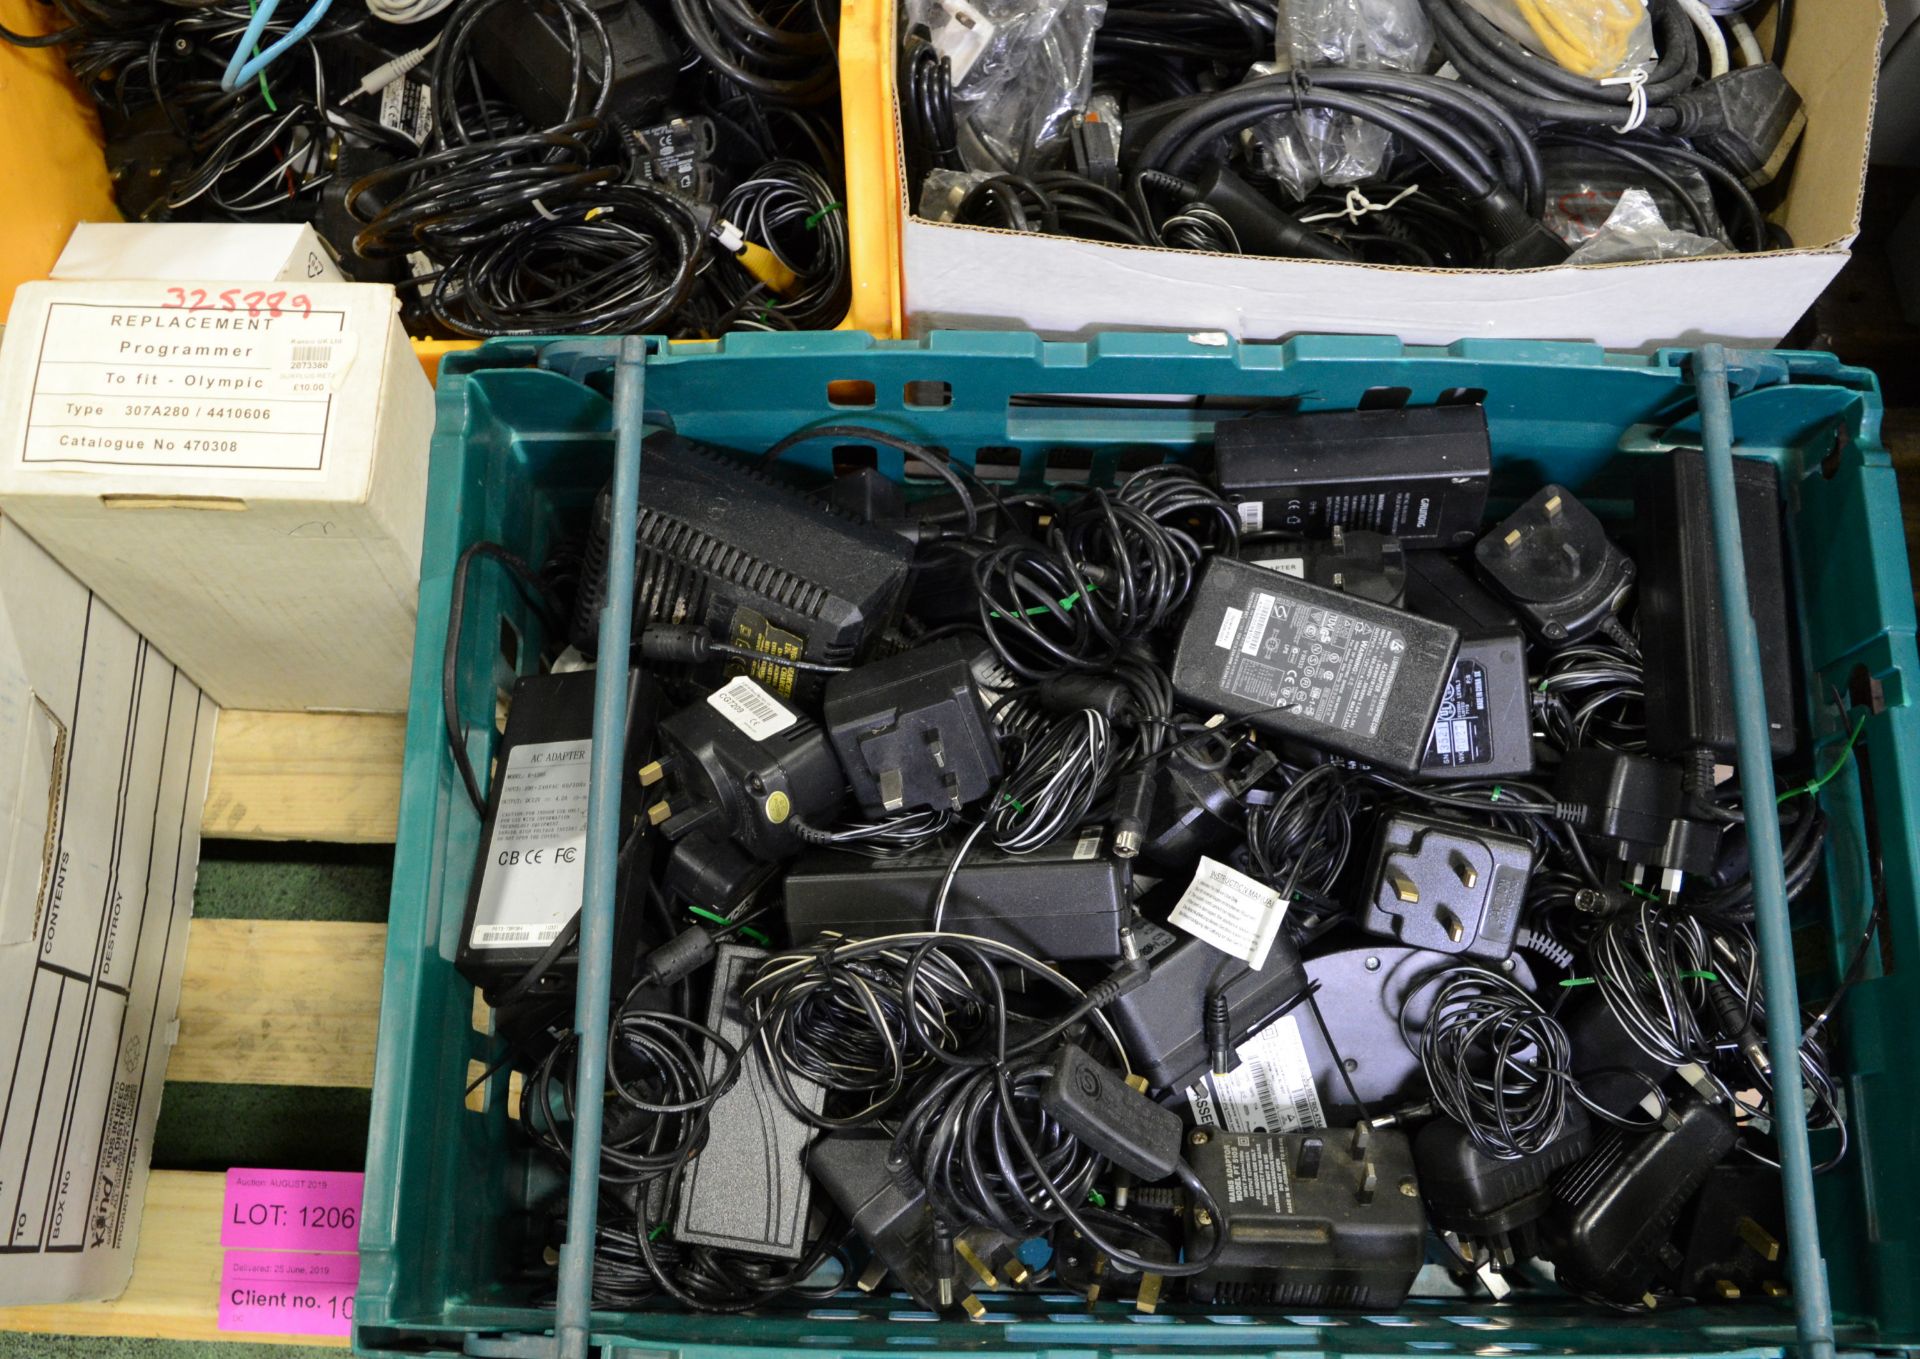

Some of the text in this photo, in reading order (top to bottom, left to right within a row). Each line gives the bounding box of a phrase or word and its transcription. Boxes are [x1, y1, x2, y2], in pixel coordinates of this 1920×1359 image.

[111, 315, 274, 330] REPLACEMENT
[120, 341, 253, 358] Programmer
[106, 372, 126, 384] To
[136, 374, 158, 385] fit
[184, 374, 264, 389] Olympic
[66, 403, 104, 416] Type
[125, 405, 190, 417] 307A280
[207, 407, 271, 420] 4410606
[59, 435, 238, 452] Catalogue No 470308
[1416, 497, 1429, 528] GRUNDIG
[1373, 669, 1386, 693] ADAPTER
[719, 693, 745, 713] CG7209
[530, 751, 585, 763] AC ADAPTER
[45, 851, 70, 954] CONTENTS
[102, 890, 124, 975] DESTROY
[105, 1081, 125, 1168] KIDS IN NEED
[114, 1083, 130, 1150] DISTRESS
[1223, 1144, 1236, 1203] MAINS ADAPTOR
[1233, 1164, 1240, 1174] PT
[270, 1180, 305, 1188] AUGUST
[1234, 1176, 1243, 1201] MODEL
[52, 1169, 71, 1238] BOX No
[14, 1211, 28, 1240] TO
[233, 1204, 355, 1230] LOT: 1206
[233, 1264, 271, 1273] Delivered:
[310, 1267, 329, 1275] 2019
[231, 1290, 286, 1308] Client
[293, 1297, 321, 1309] no.
